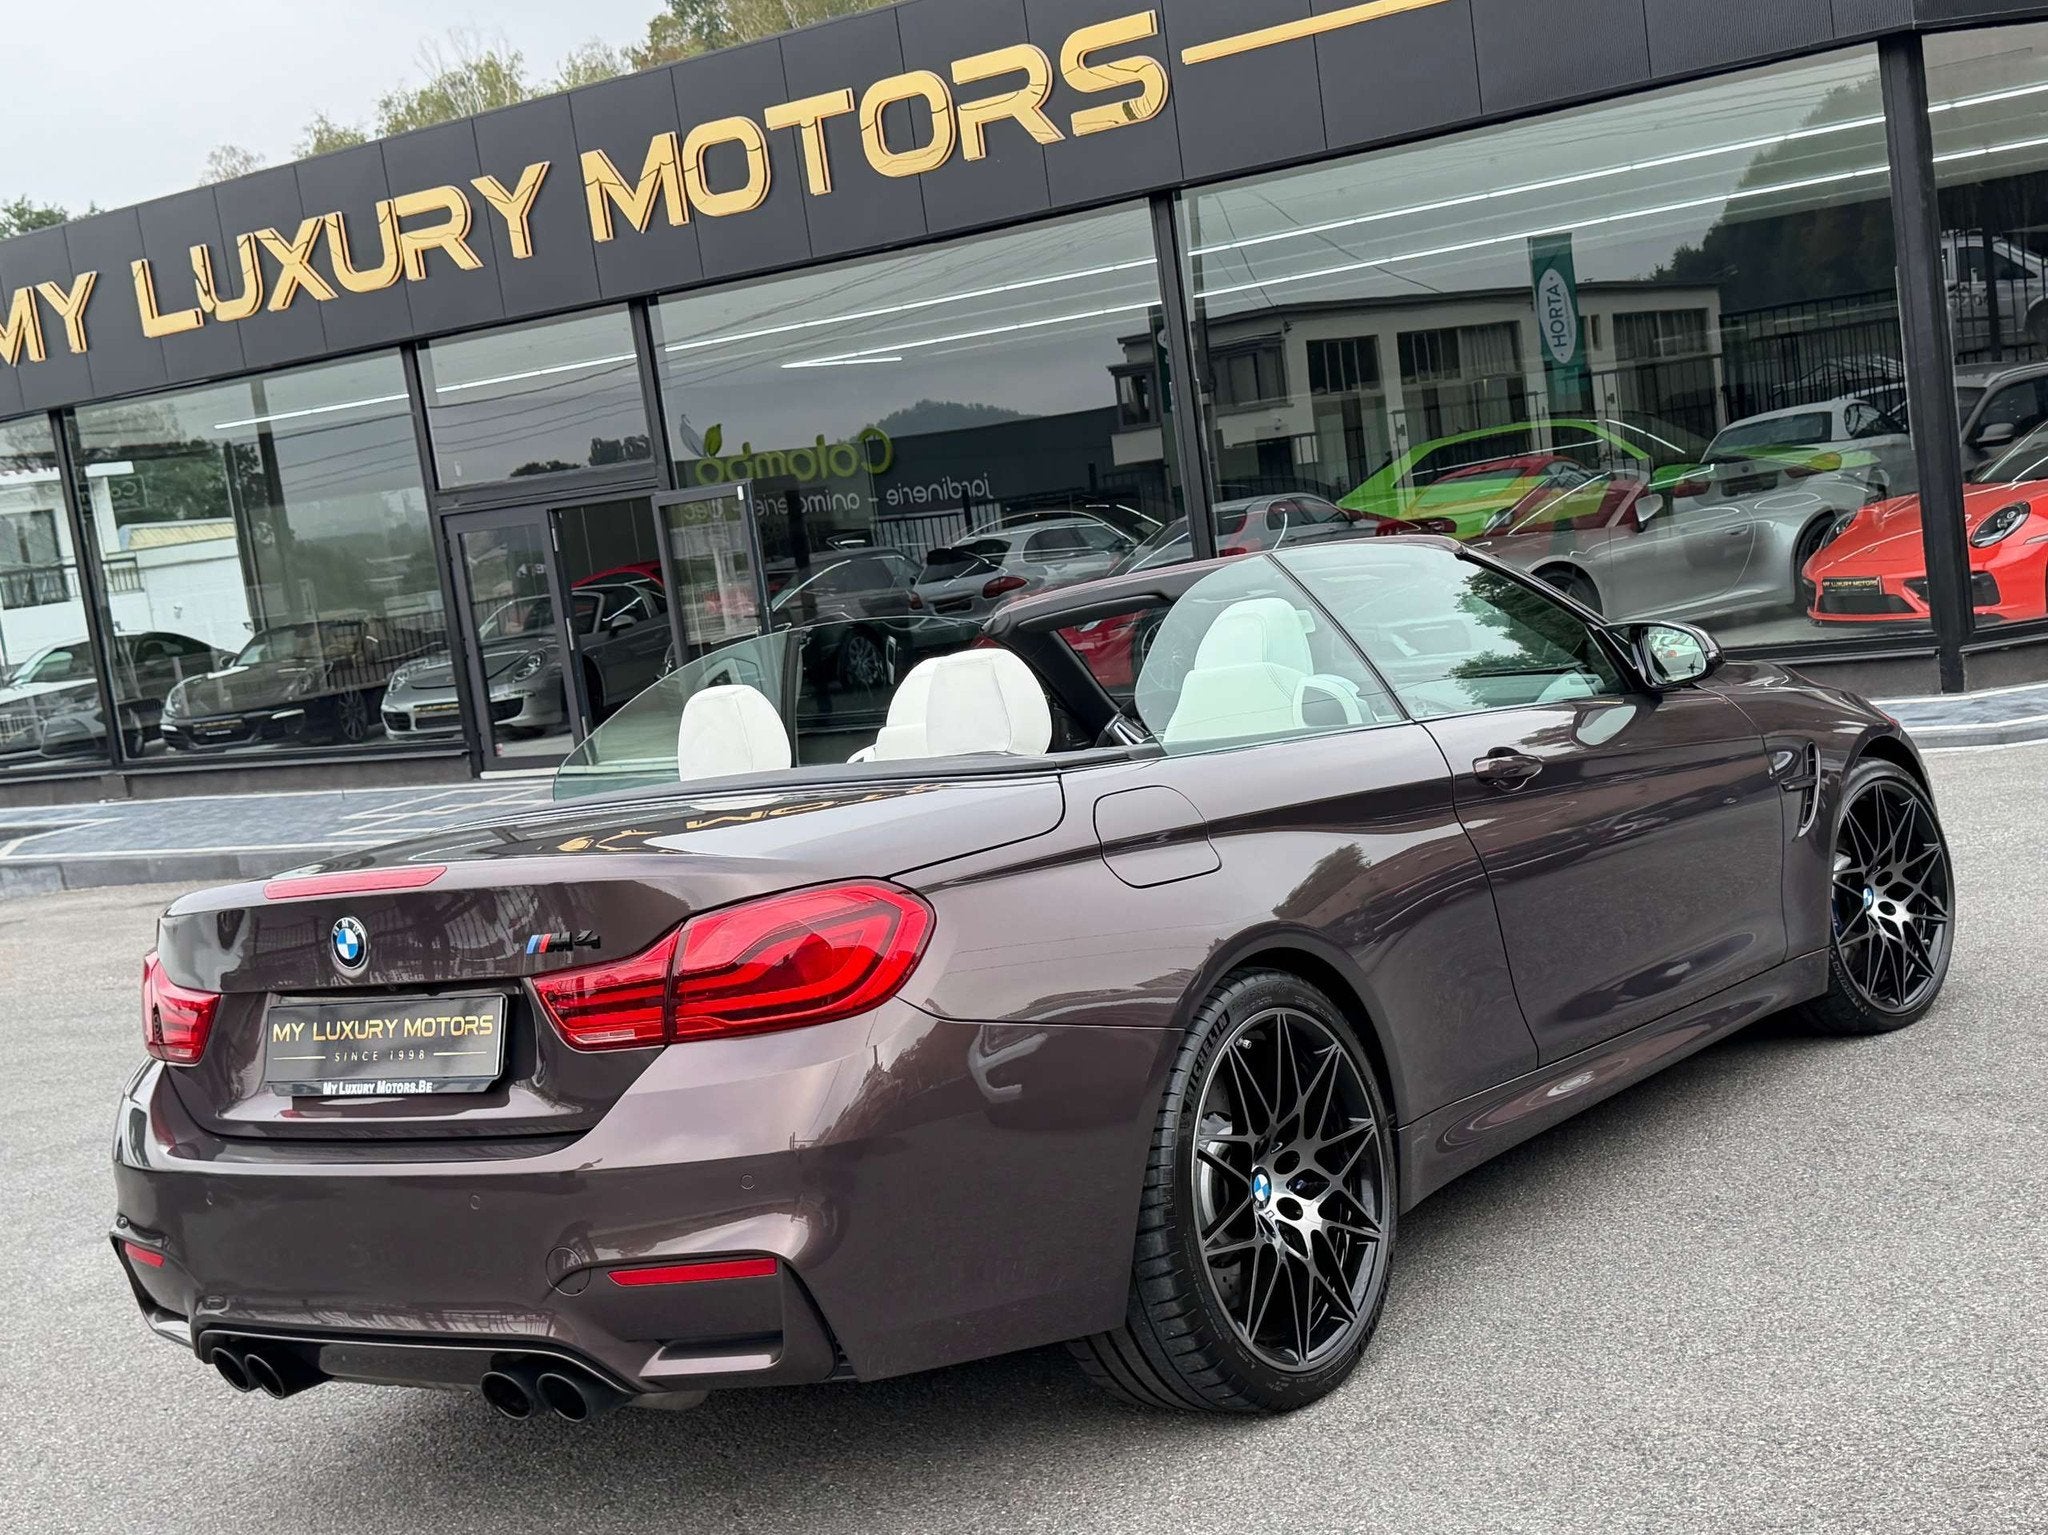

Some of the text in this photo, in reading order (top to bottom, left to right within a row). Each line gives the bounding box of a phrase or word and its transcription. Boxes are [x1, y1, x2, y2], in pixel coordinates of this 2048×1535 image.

[0, 9, 1169, 367] MY LUXURY MOTORS
[1546, 283, 1568, 348] HORTA
[272, 1014, 494, 1043] MY LUXURY MOTORS
[334, 1049, 426, 1063] SINCE 1998
